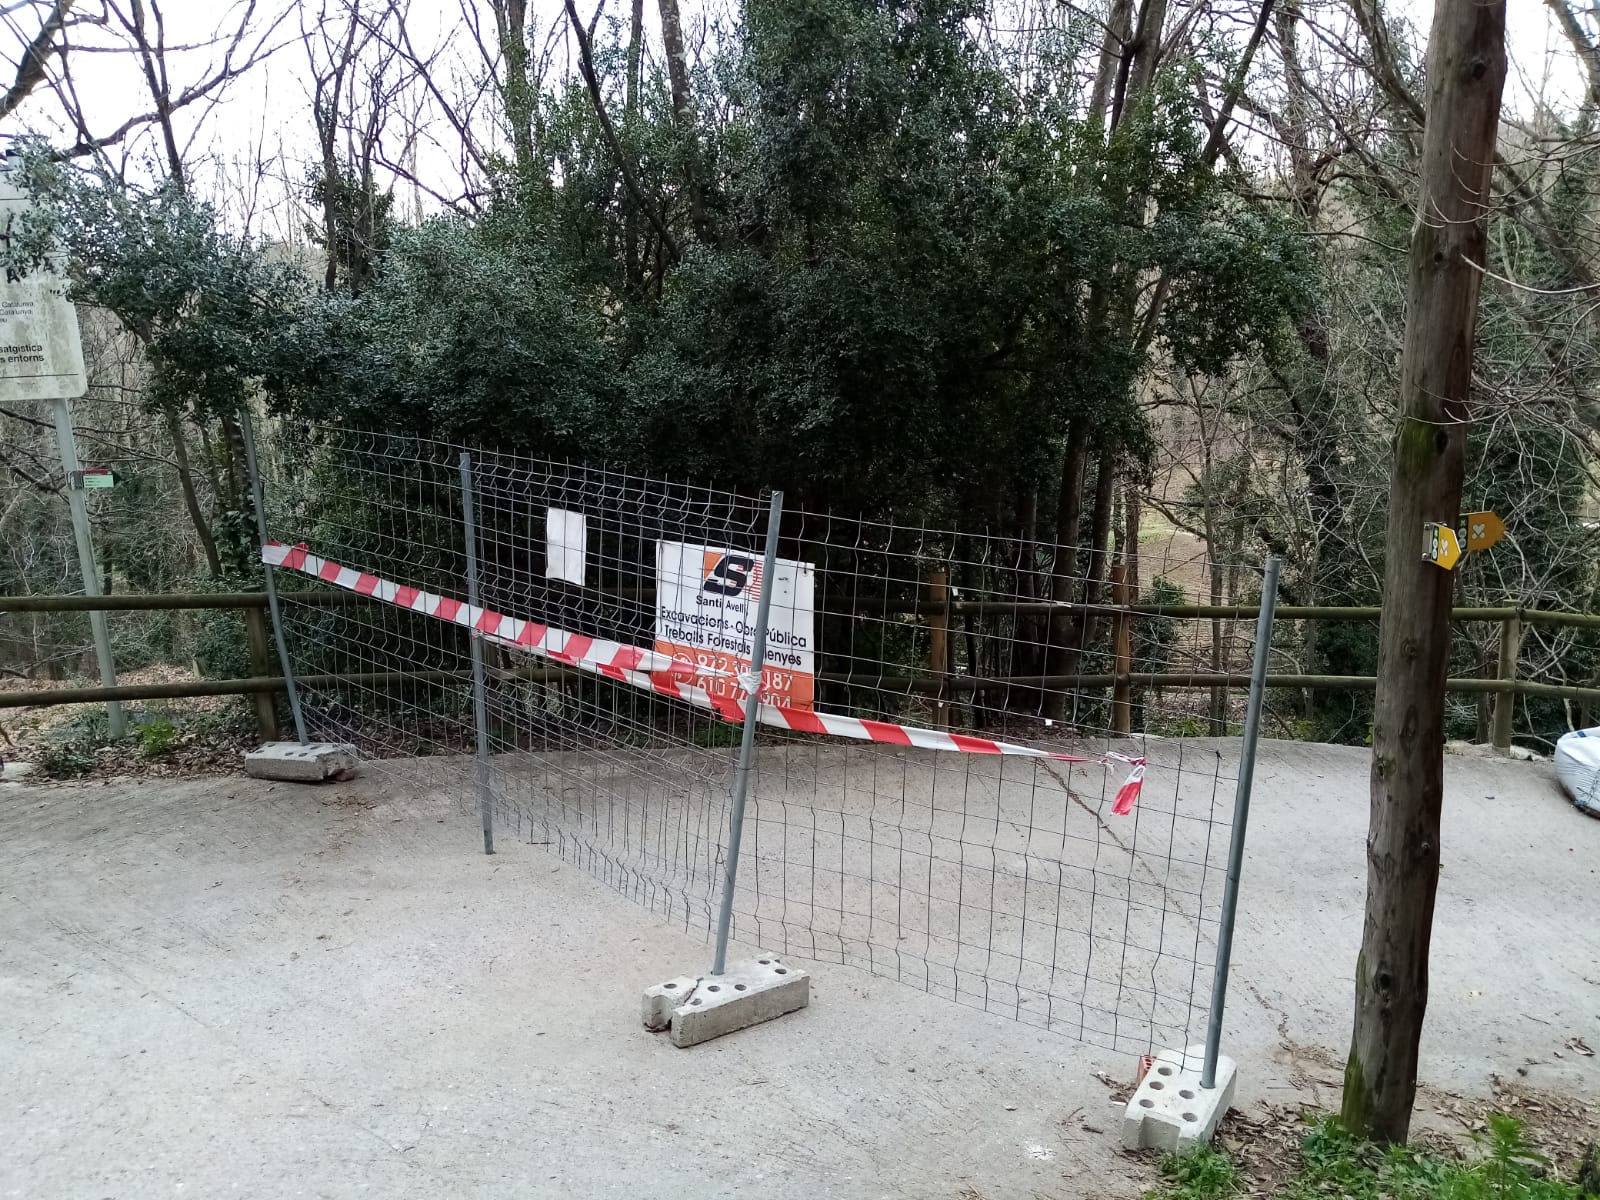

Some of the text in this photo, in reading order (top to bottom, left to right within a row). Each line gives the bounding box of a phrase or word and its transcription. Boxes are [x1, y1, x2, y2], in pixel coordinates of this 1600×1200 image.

[8, 355, 45, 363] entorns
[696, 595, 722, 608] Santi
[661, 606, 729, 630] Excavacions
[735, 620, 756, 637] Obr
[665, 624, 704, 644] Treballs
[707, 633, 751, 655] Forestals
